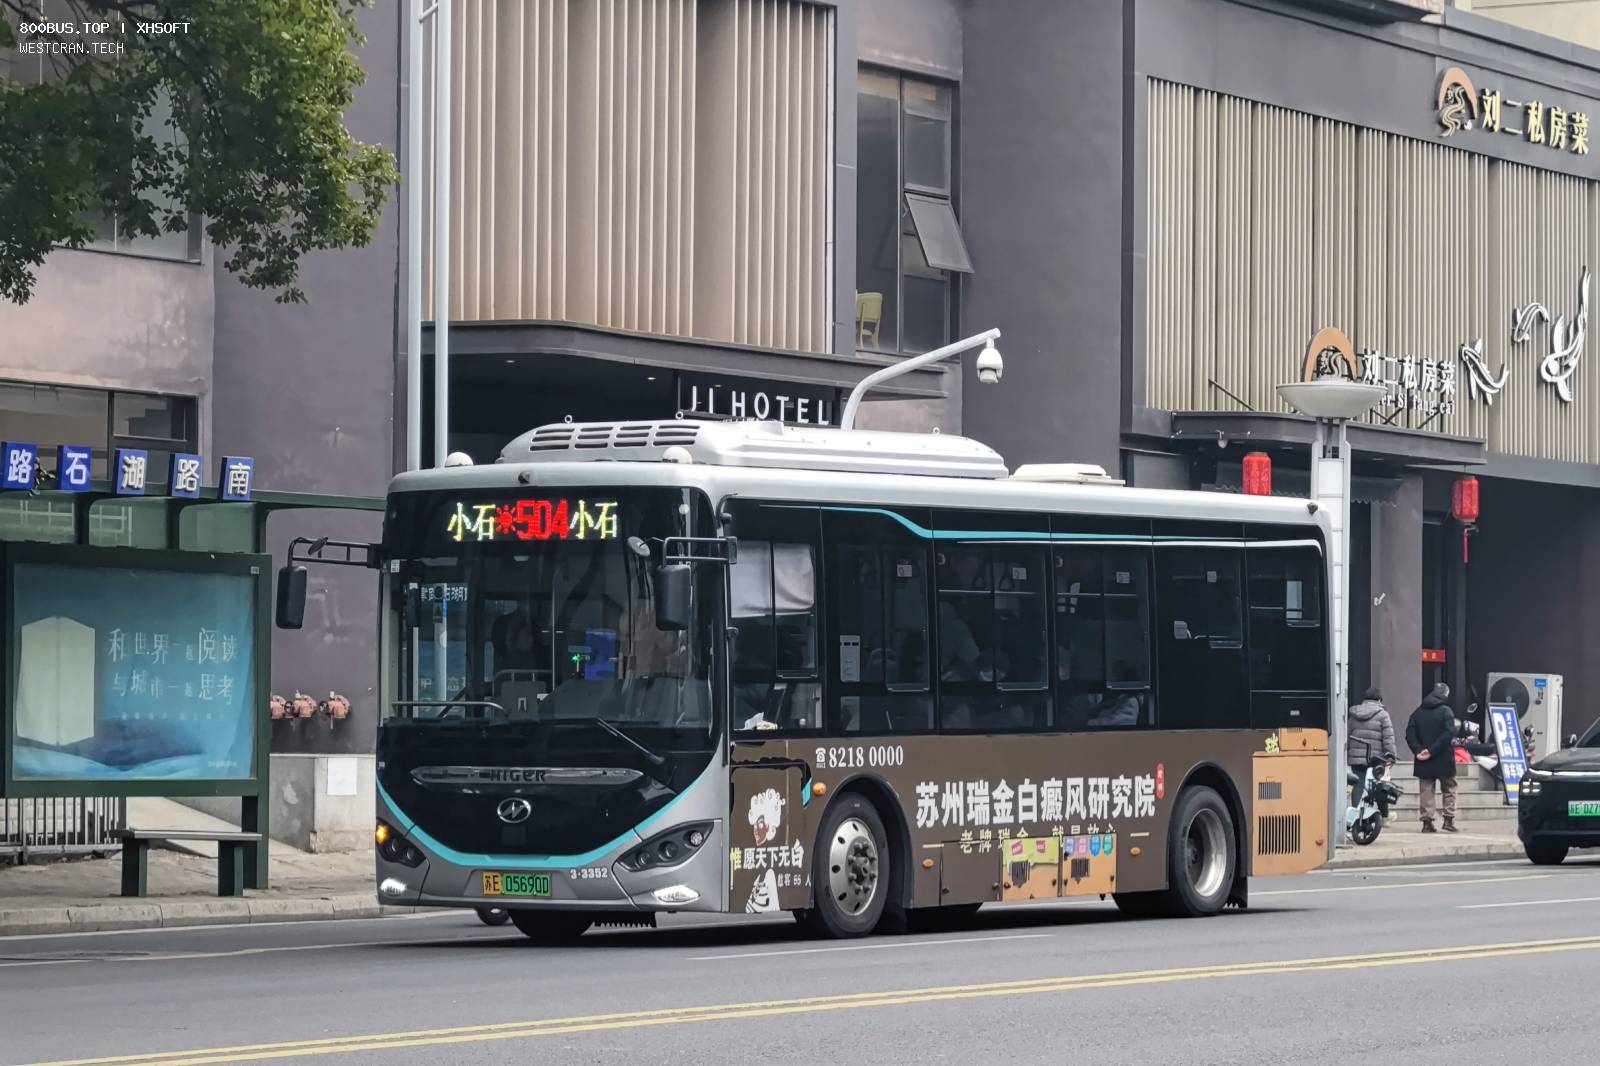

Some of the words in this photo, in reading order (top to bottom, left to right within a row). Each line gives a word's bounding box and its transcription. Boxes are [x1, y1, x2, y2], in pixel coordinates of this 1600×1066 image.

[1482, 87, 1590, 154] 刘二私房菜
[1362, 349, 1455, 395] 刘二私房菜
[691, 385, 714, 414] JI
[731, 390, 829, 425] HOTEL
[447, 502, 496, 541] 小石
[516, 499, 569, 540] 504
[569, 500, 618, 540] 小石
[829, 746, 865, 768] 8218
[869, 745, 904, 767] 0000
[915, 773, 1156, 829] 苏州瑞金白癜风研究院
